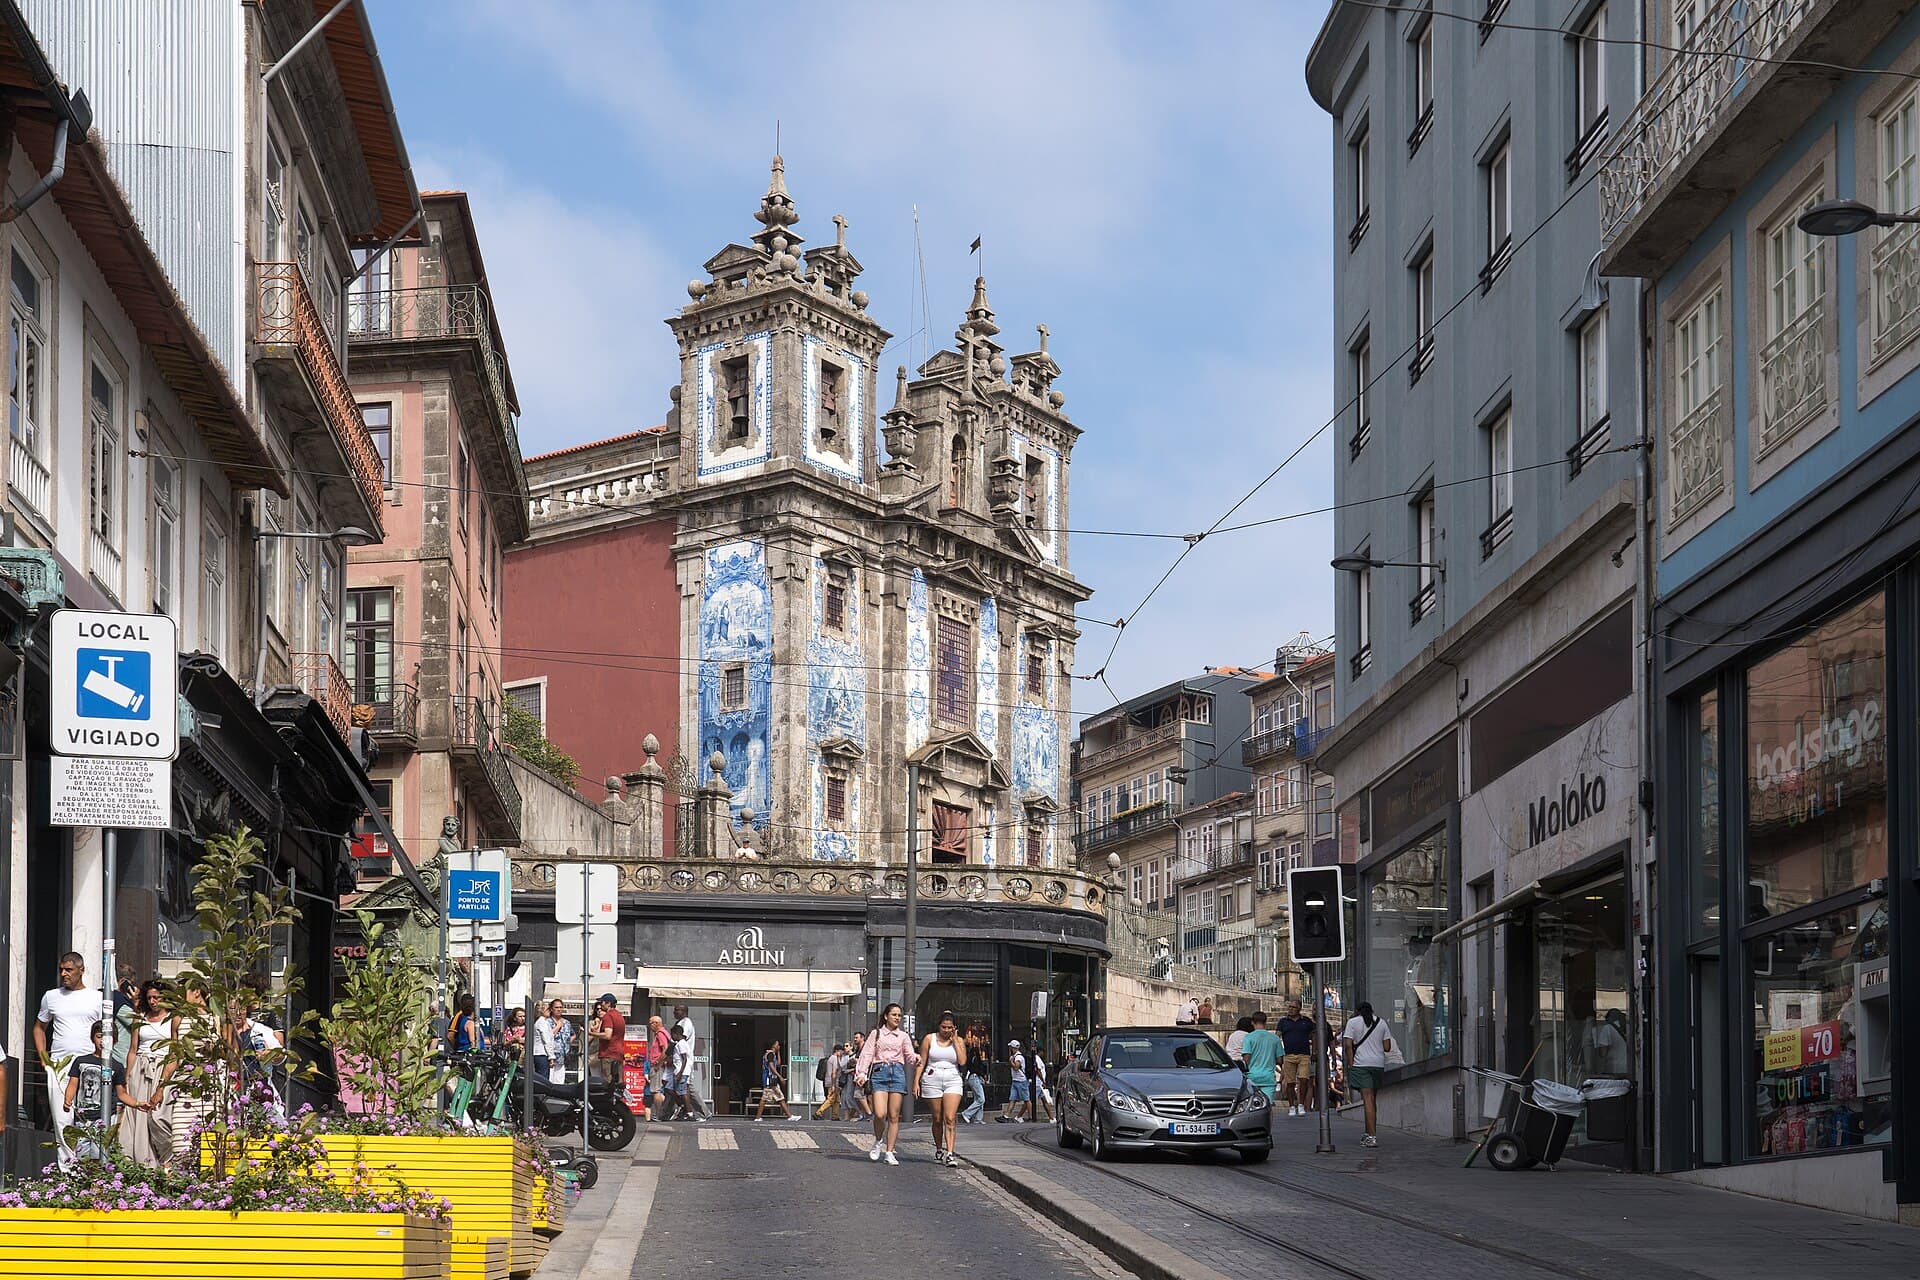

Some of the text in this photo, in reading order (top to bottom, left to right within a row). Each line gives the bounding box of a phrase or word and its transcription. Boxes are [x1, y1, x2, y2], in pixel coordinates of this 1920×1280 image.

[79, 622, 150, 640] LOCAL
[67, 728, 160, 747] VIGIADO
[1756, 700, 1879, 791] backstage
[1529, 773, 1606, 849] Moloko
[717, 949, 785, 966] ABILINI
[1866, 969, 1884, 987] ATM
[735, 991, 765, 999] ABILINI
[1769, 1034, 1796, 1046] SALDOS
[1778, 1072, 1827, 1101] OUTLET
